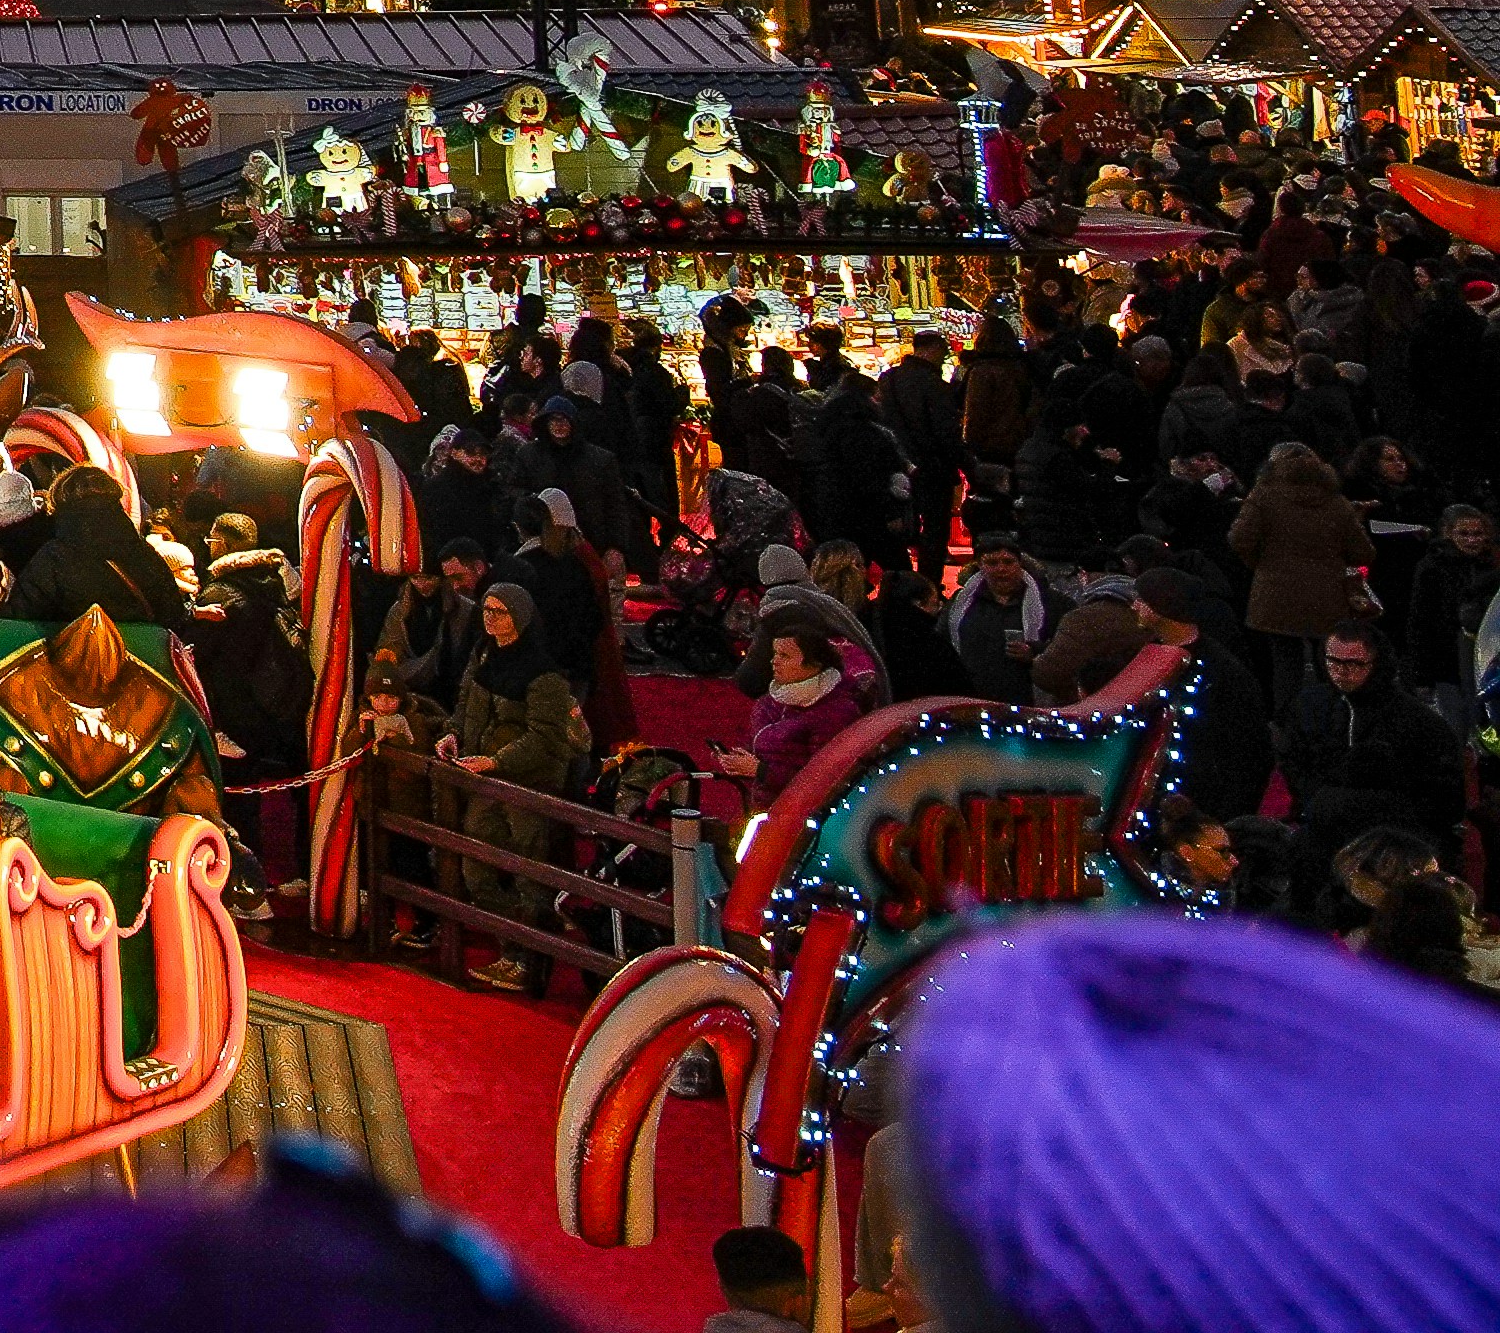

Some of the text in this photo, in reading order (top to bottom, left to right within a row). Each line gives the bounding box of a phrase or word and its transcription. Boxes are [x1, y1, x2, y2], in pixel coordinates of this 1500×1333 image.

[60, 94, 125, 112] LOCATION
[306, 97, 362, 112] DRON
[869, 789, 1104, 930] SORTIE
